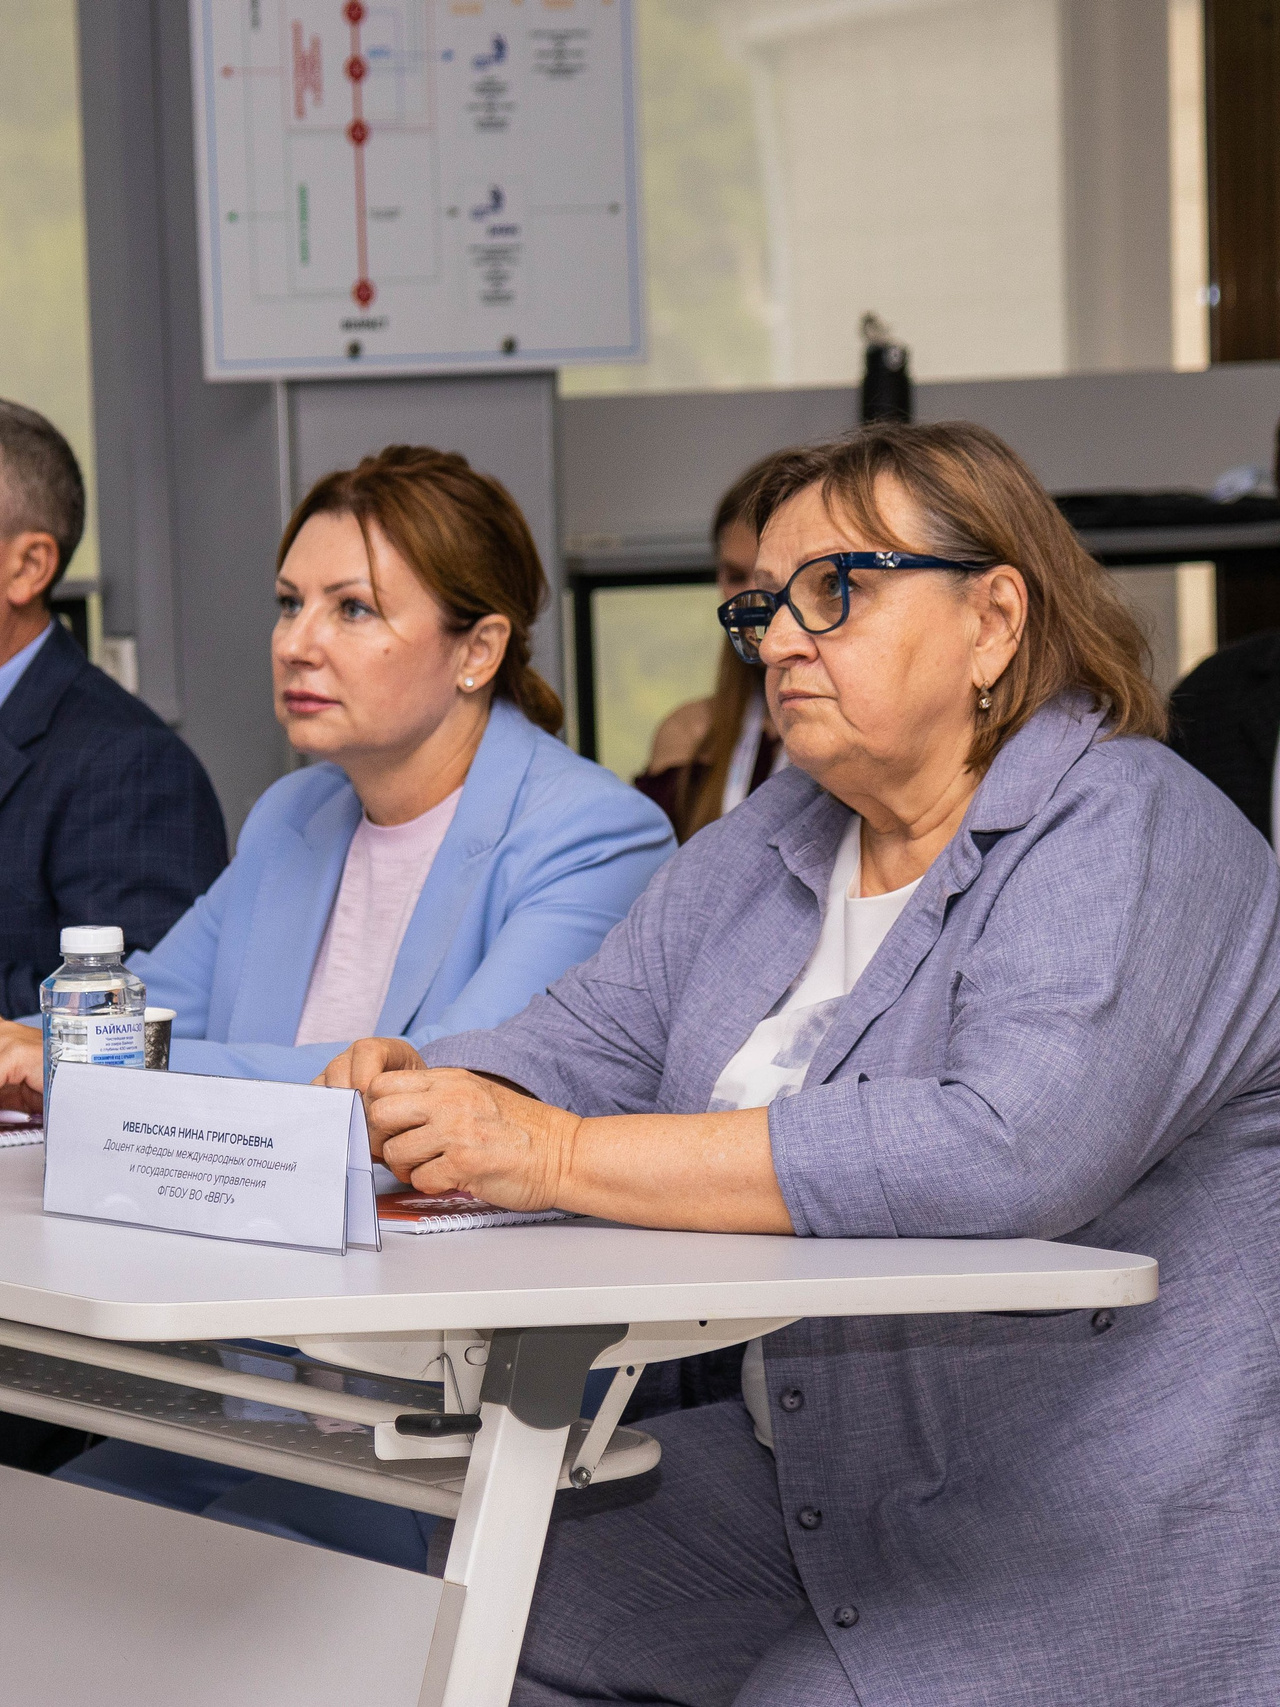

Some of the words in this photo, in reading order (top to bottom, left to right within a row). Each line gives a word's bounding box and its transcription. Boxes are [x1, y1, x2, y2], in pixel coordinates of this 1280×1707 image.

[95, 1023, 132, 1035] БАЙКАЛ
[122, 1120, 176, 1137] ИВЕЛЬСКАЯ
[178, 1127, 204, 1141] НИНА
[206, 1130, 274, 1149] ГРИГОРЬЕВНА
[103, 1138, 135, 1152] Доцент
[135, 1144, 174, 1158] кафедры
[176, 1149, 246, 1166] международных
[246, 1158, 297, 1172] отношений
[129, 1164, 135, 1172] и
[136, 1164, 212, 1182] государственного
[213, 1174, 267, 1189] управления
[157, 1185, 189, 1199] ФГБОУ
[189, 1188, 203, 1201] ВО
[204, 1190, 235, 1204] «ВВГУ»
